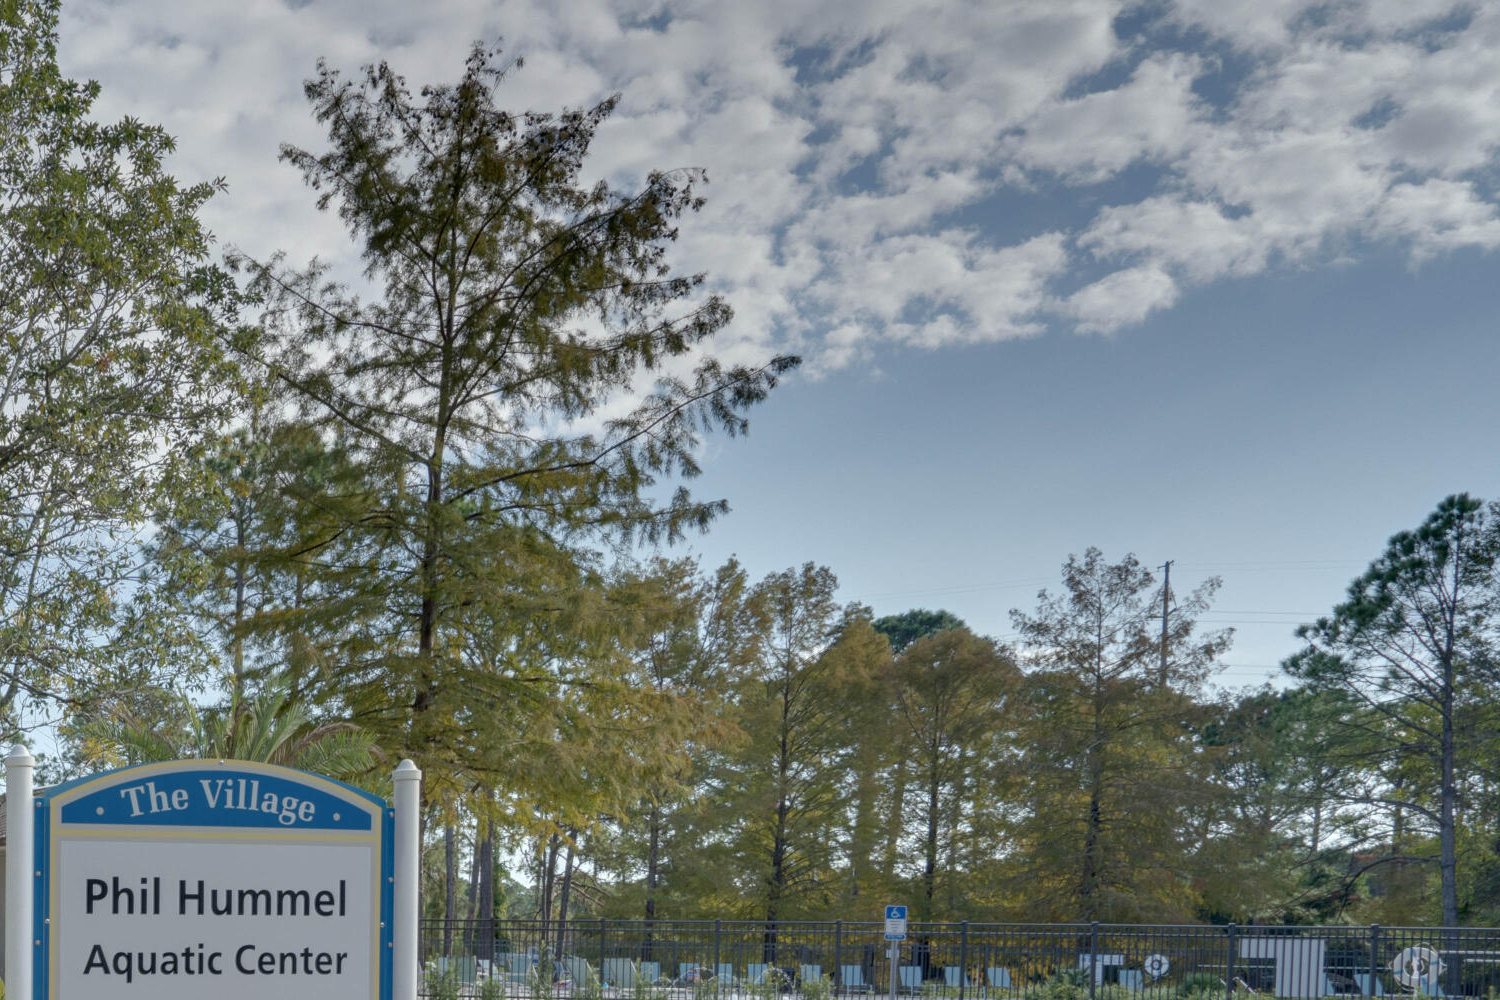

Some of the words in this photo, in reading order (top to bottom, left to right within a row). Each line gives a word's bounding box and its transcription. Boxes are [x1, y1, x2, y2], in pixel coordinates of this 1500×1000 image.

[120, 782, 188, 817] The
[199, 778, 316, 825] Village
[85, 876, 161, 915] Phil
[178, 879, 346, 917] Hummel
[82, 943, 223, 984] Aquatic
[234, 944, 348, 976] Center
